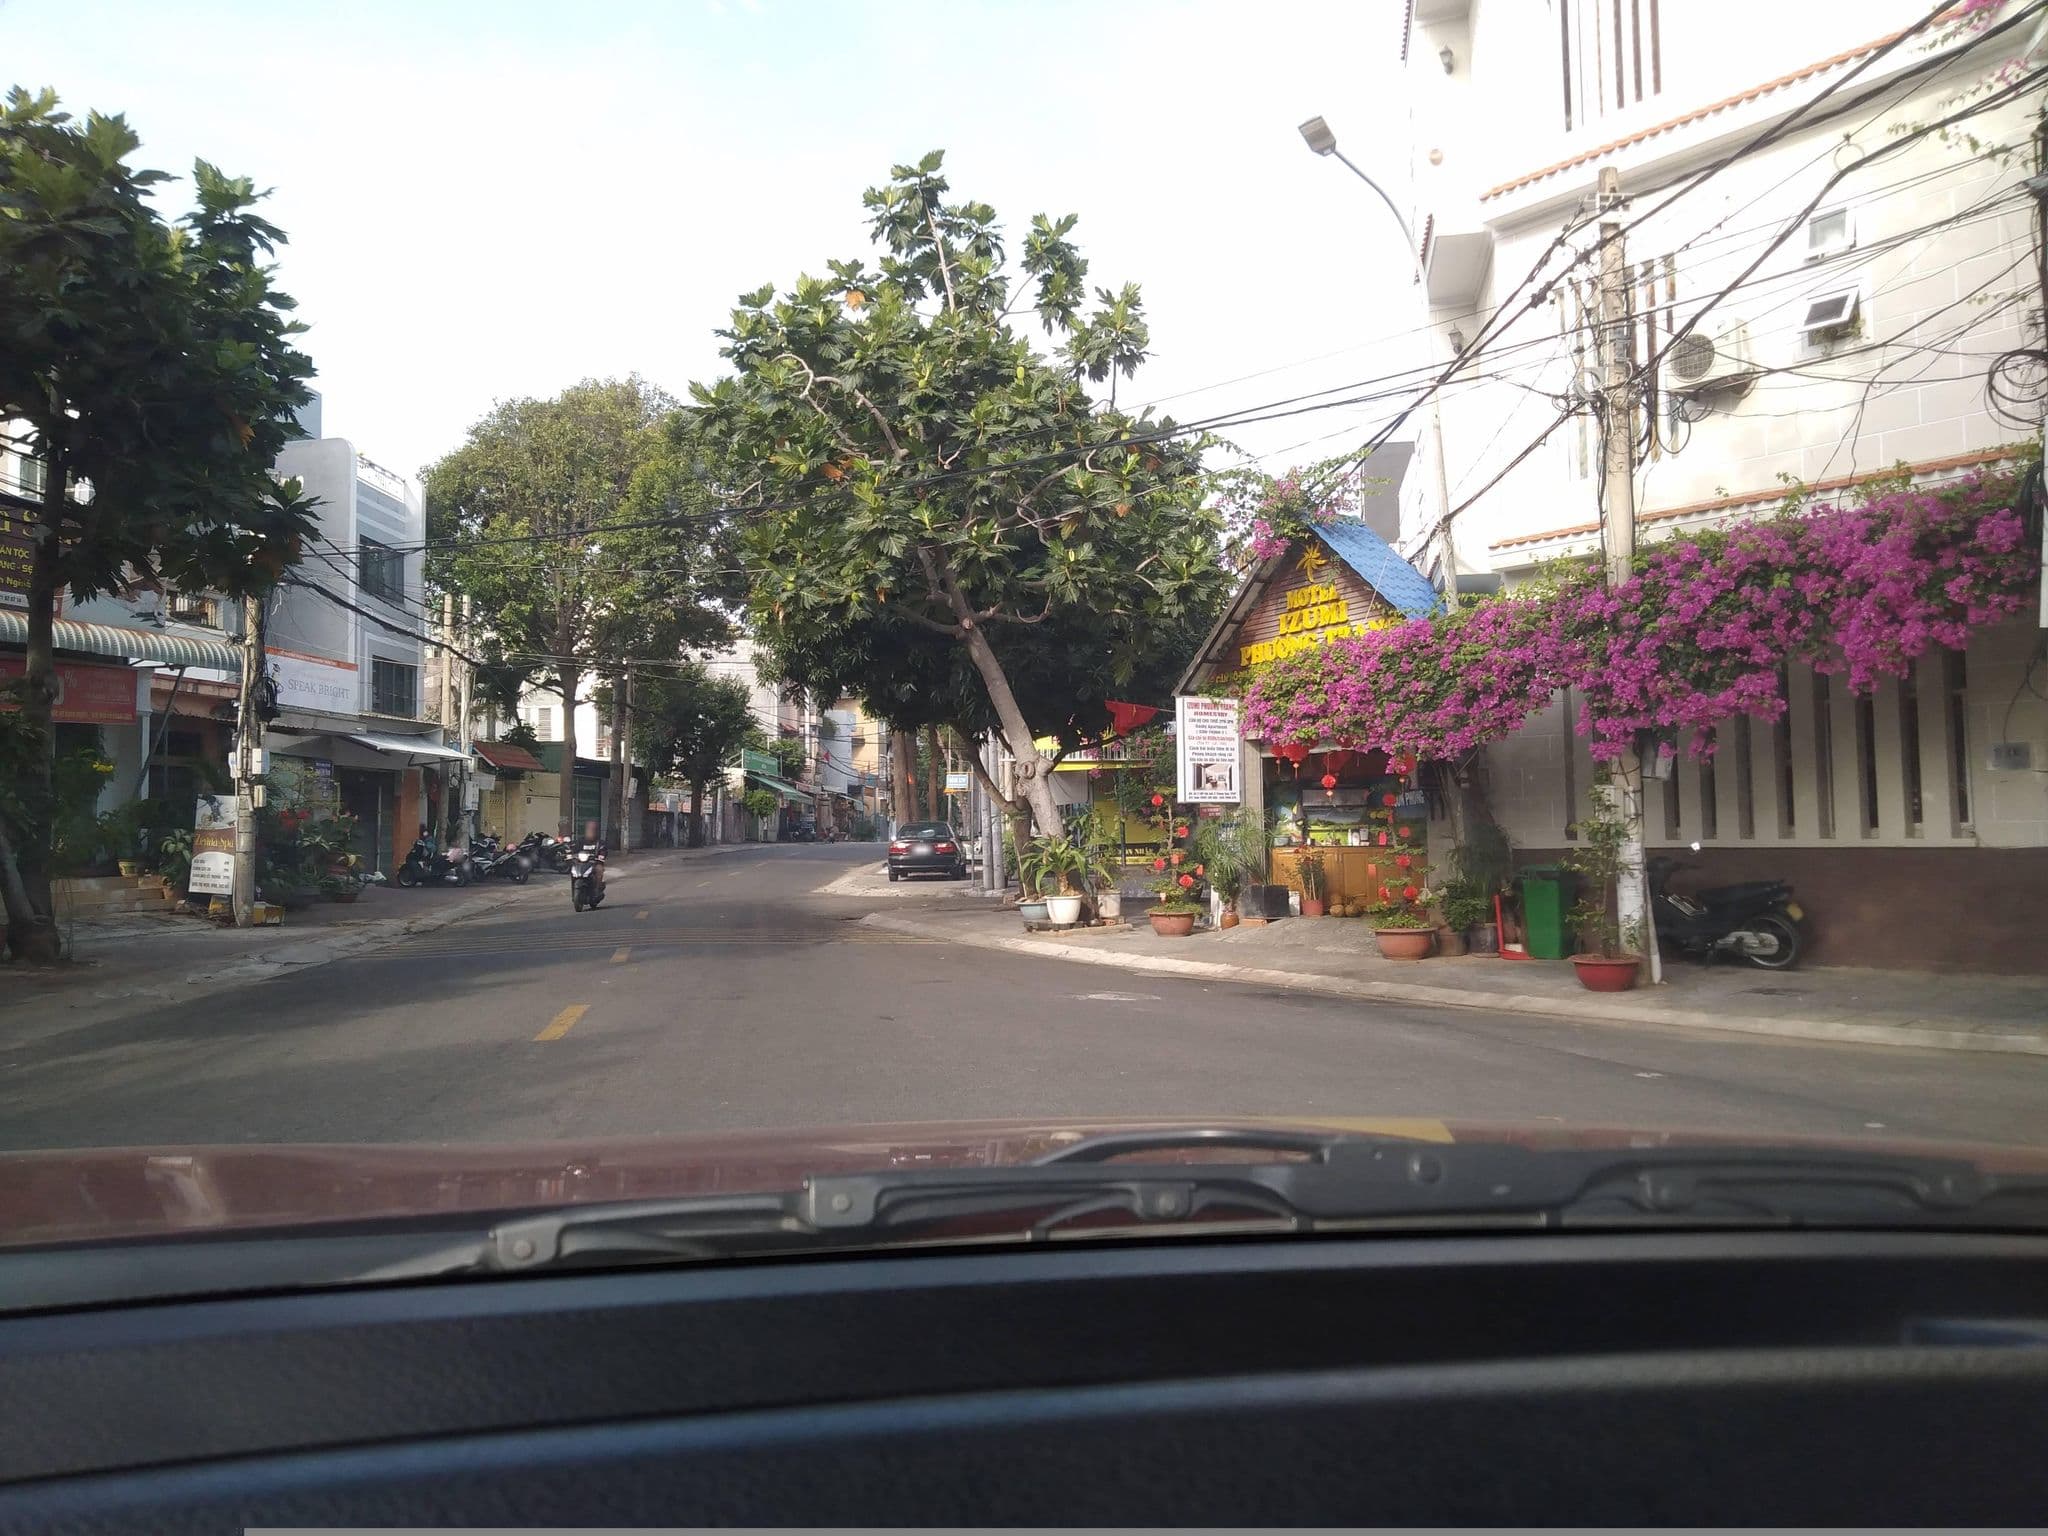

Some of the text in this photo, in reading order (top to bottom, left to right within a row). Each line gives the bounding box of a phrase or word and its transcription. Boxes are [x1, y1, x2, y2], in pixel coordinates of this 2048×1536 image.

[1285, 584, 1337, 609] MOTEL
[1279, 601, 1349, 634] IZUMI
[288, 678, 350, 699] SPEAK BRIGHT
